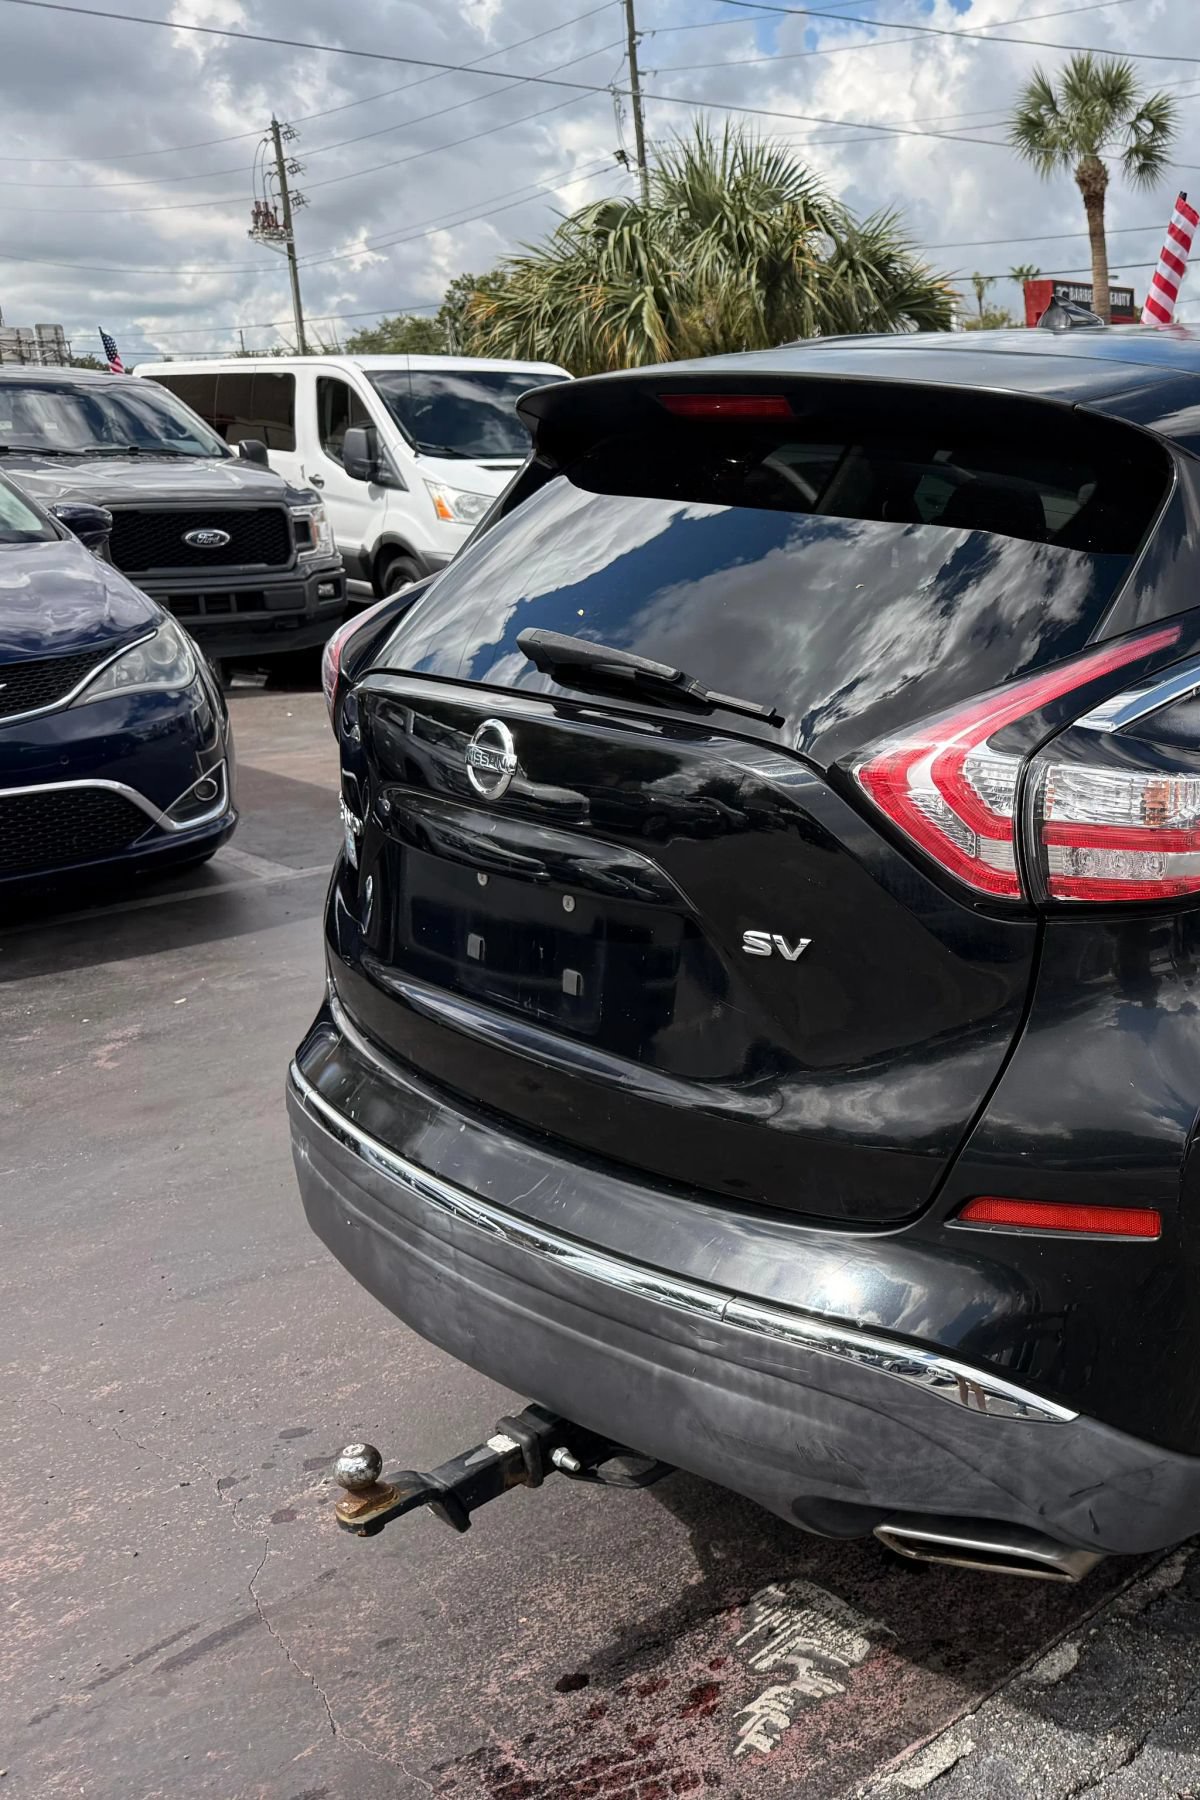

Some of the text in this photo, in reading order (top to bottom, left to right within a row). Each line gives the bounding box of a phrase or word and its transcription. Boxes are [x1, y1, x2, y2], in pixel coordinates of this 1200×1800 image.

[197, 532, 220, 544] Ford
[465, 746, 507, 770] NISSAN
[742, 930, 812, 961] SV
